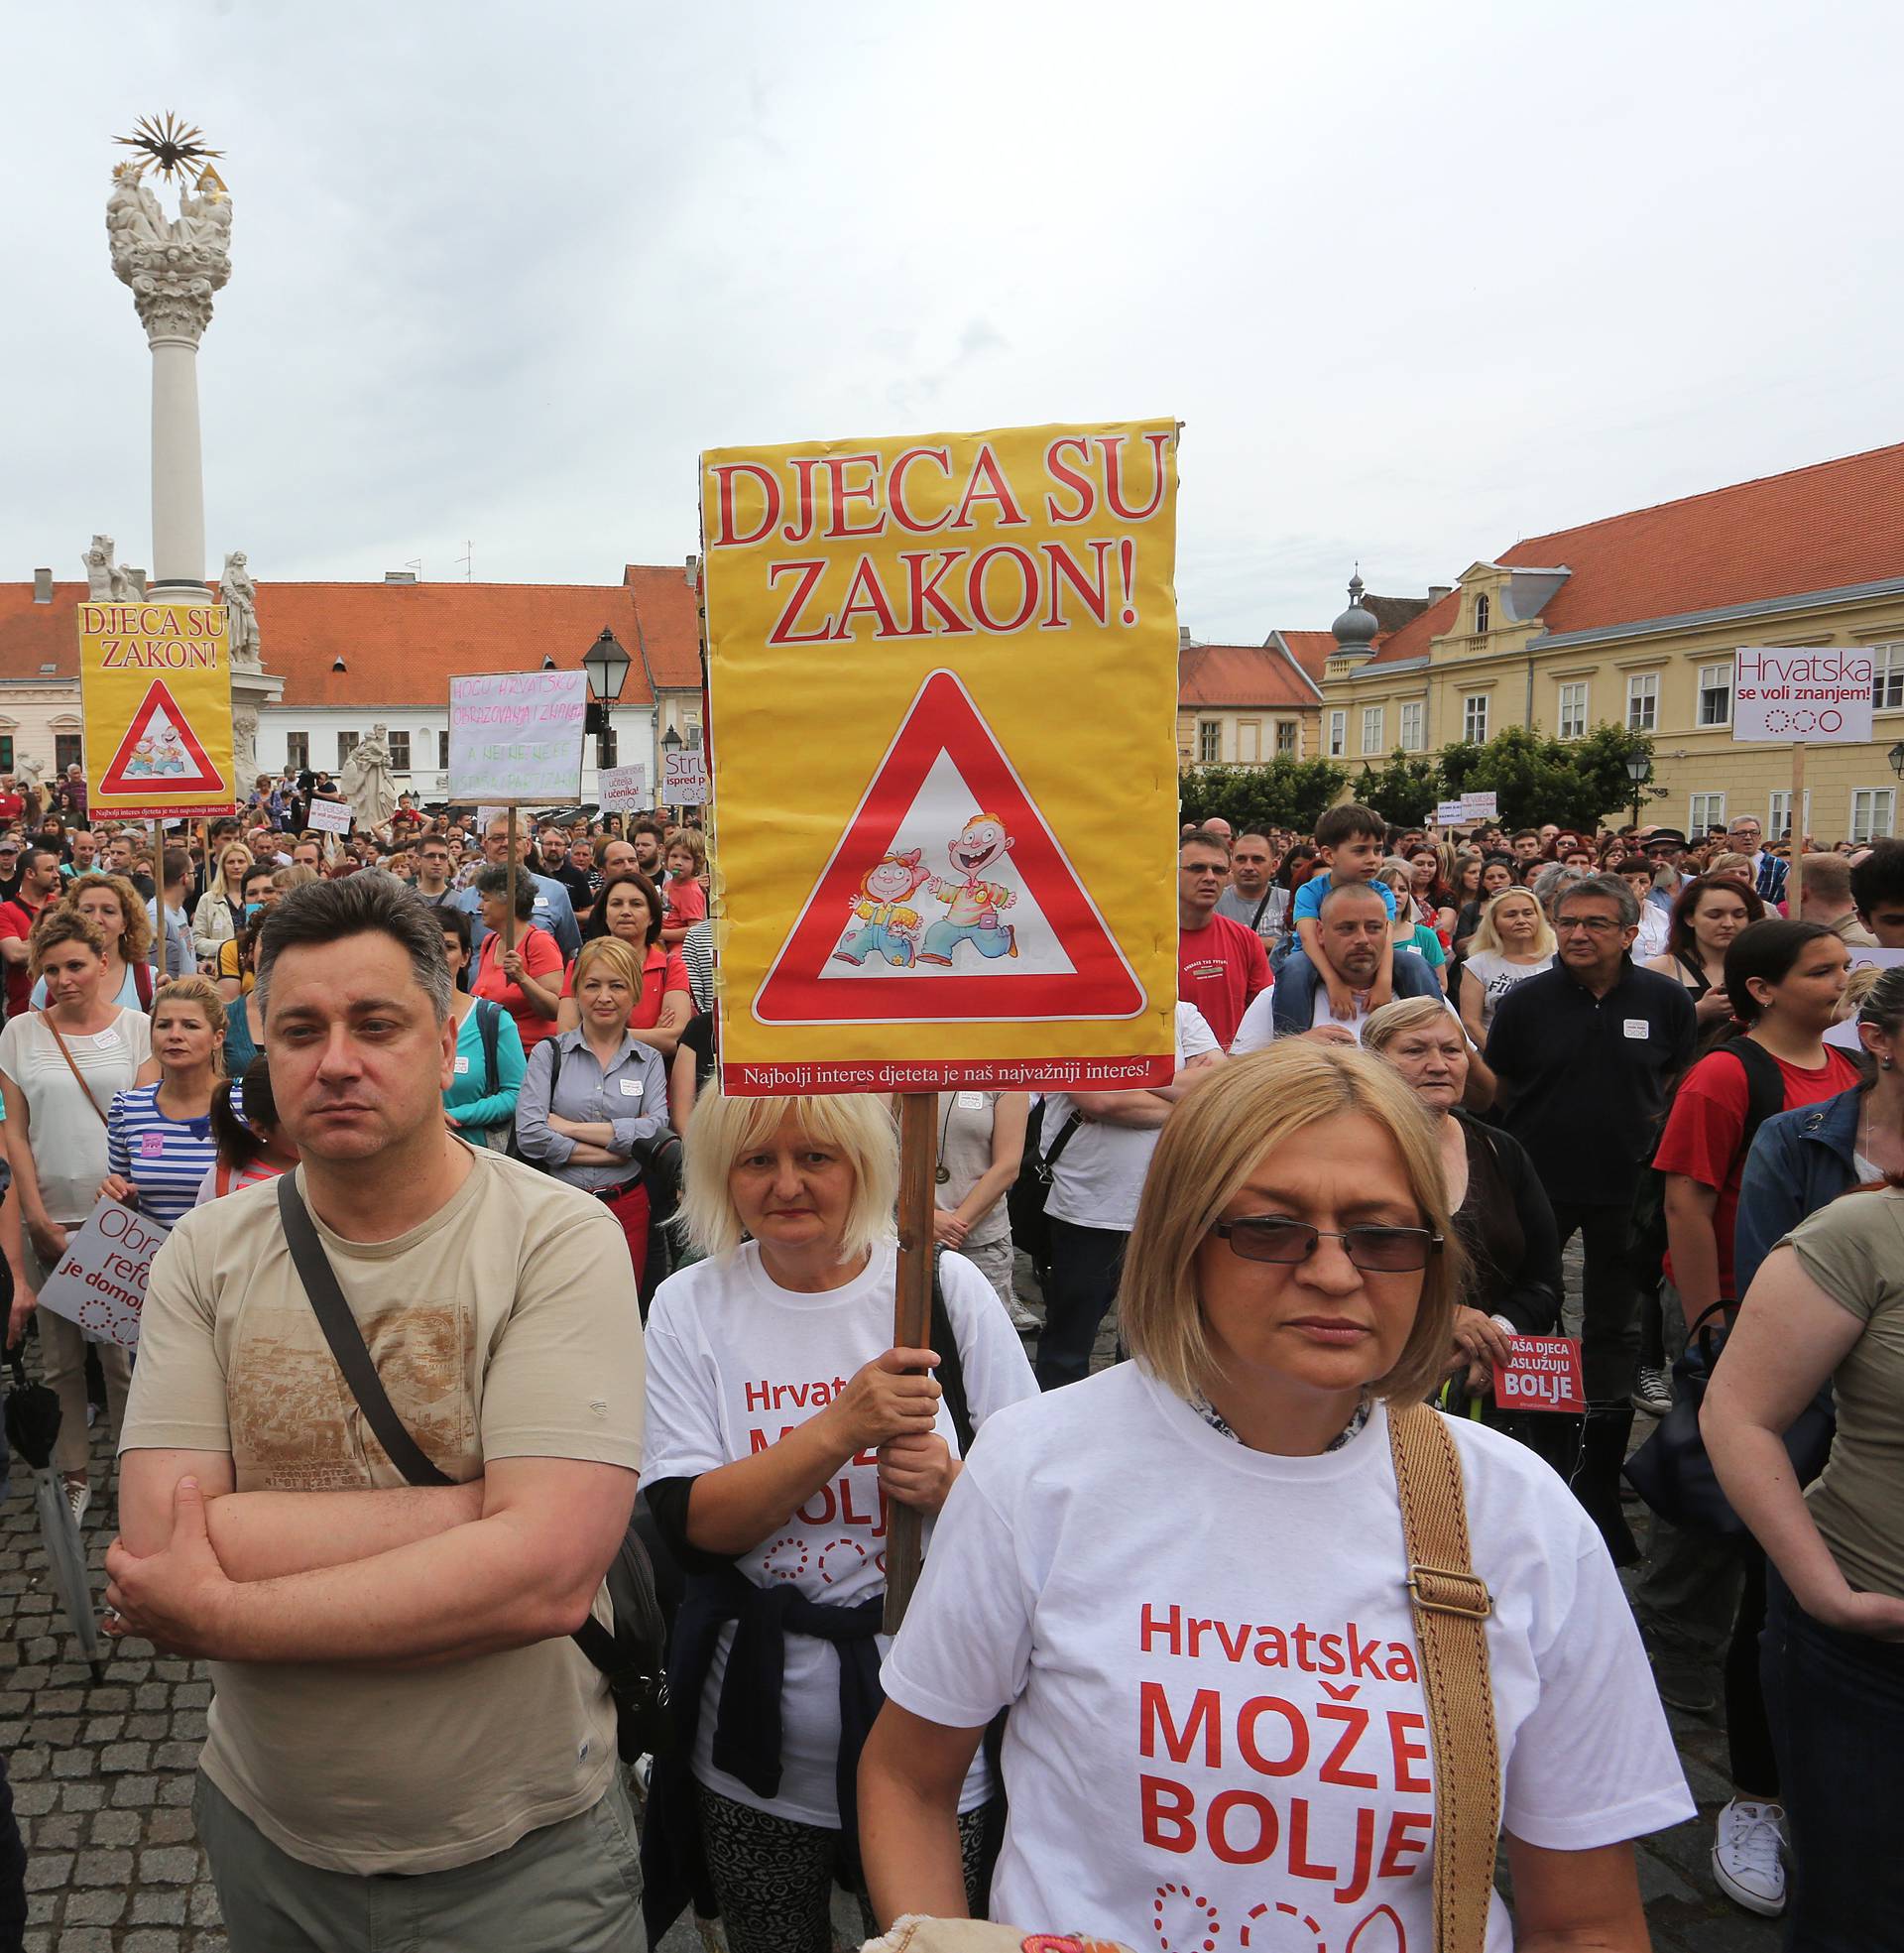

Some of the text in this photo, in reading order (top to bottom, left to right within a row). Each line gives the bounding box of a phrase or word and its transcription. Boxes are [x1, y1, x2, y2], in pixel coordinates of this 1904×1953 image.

[710, 433, 1171, 548] DJECA SU
[768, 538, 1136, 645] ZAKON!
[82, 607, 226, 637] DJECA SU
[101, 641, 216, 669] ZAKON!
[1738, 651, 1871, 682] Hrvatska
[1737, 685, 1870, 703] se voli znanjem!
[665, 753, 705, 775] Stru
[608, 786, 639, 798] učenika!
[609, 776, 633, 788] učitelja
[666, 775, 705, 787] ispred p
[95, 808, 119, 817] Najbolji
[141, 807, 162, 816] djeteta
[744, 1060, 1150, 1088] Najbolji interes djeteta je naš najvažniji interes!
[59, 1258, 83, 1278] je
[1511, 1338, 1569, 1356] AŠA DJECA
[1507, 1356, 1570, 1374] ASLUŽUJU
[745, 1377, 847, 1412] Hrvat
[1504, 1373, 1572, 1404] BOLJE
[785, 1476, 889, 1537] OLJ
[1140, 1603, 1418, 1683] Hrvatska
[1140, 1680, 1432, 1793] MOŽE
[1140, 1773, 1432, 1903] BOLJE
